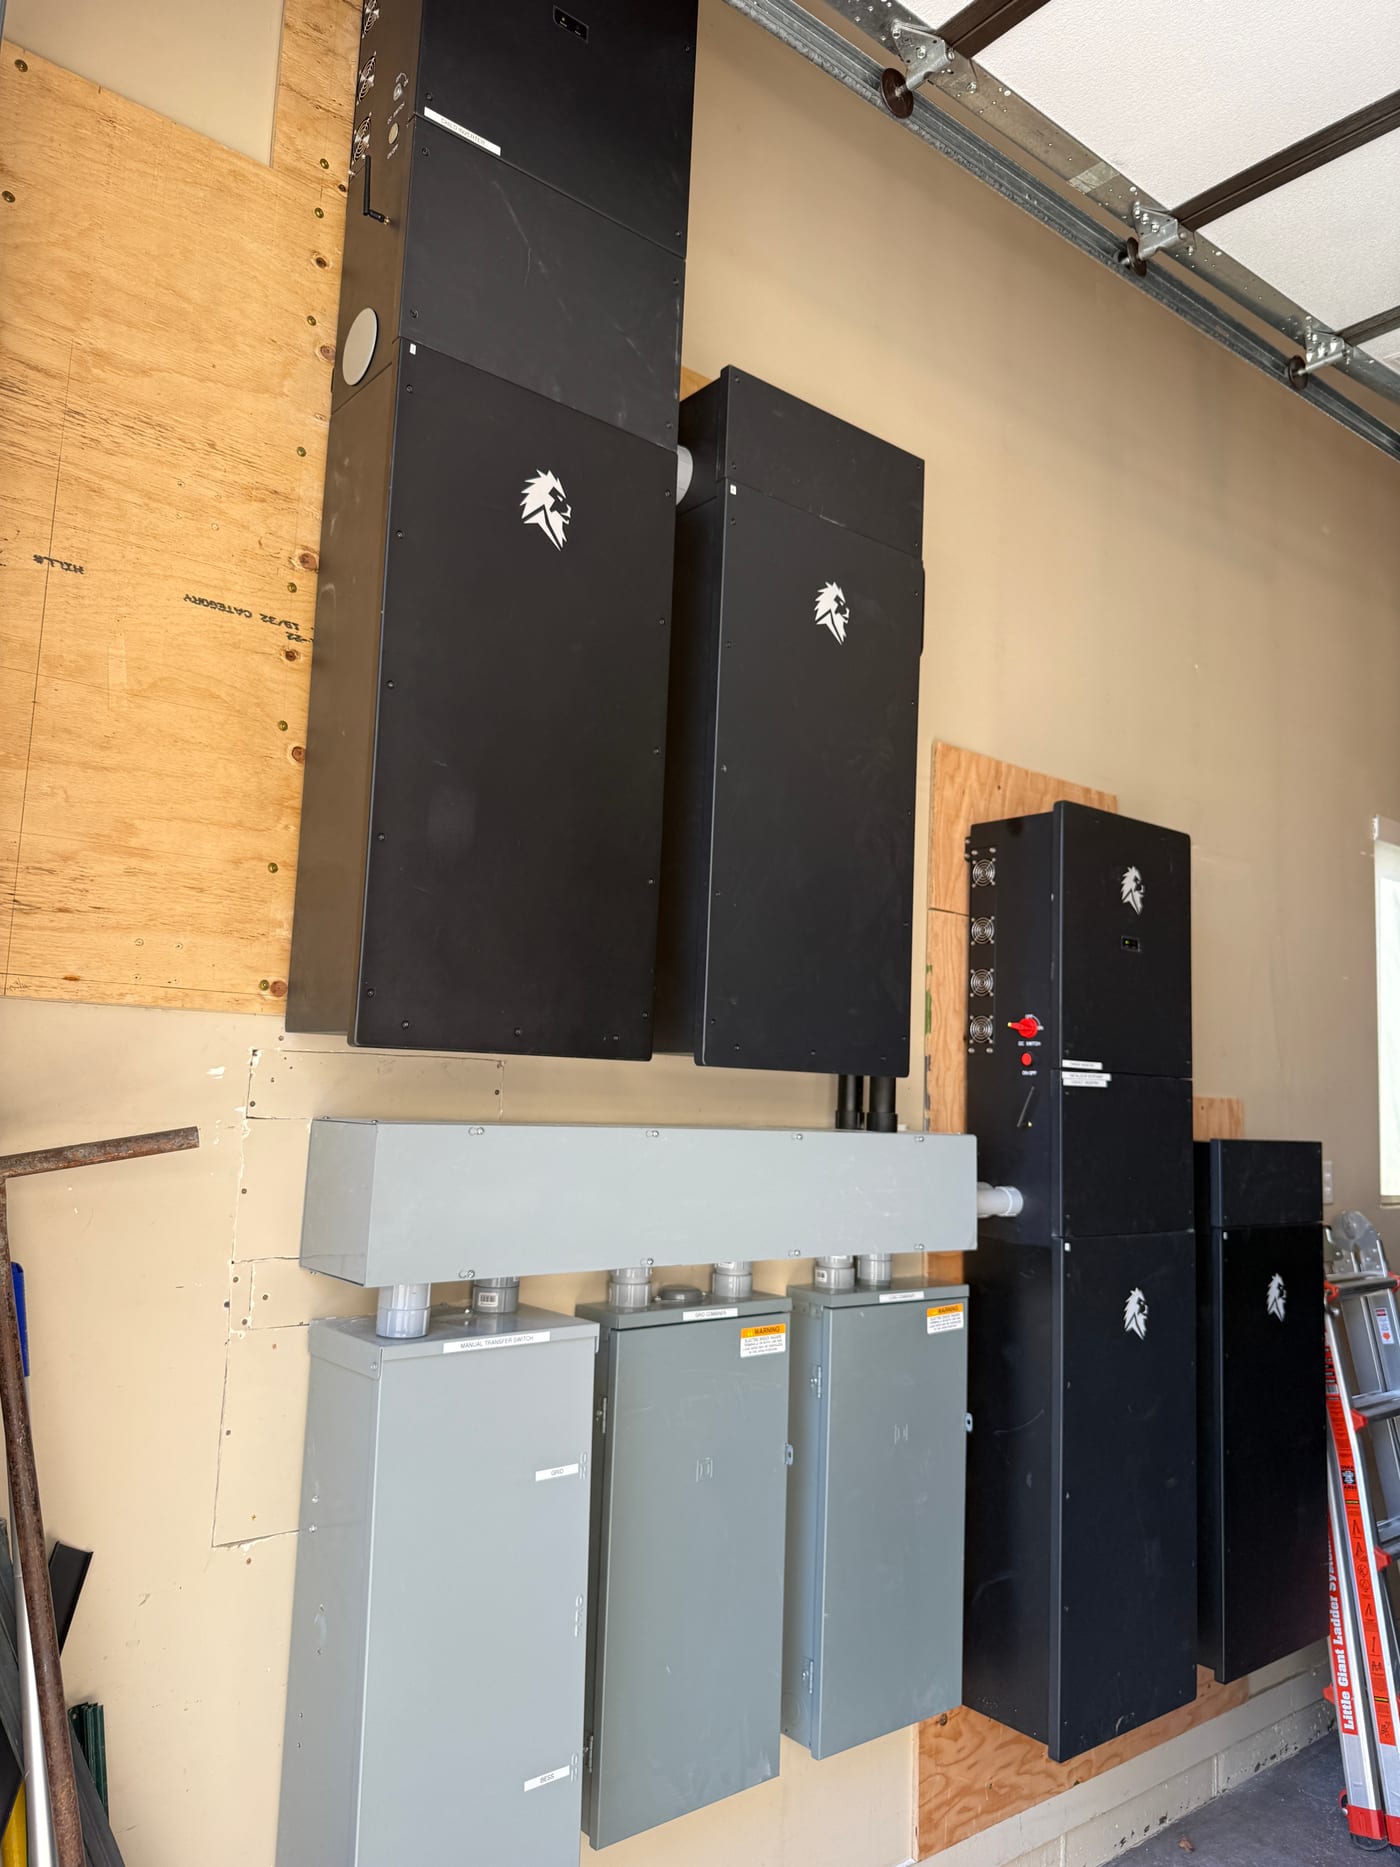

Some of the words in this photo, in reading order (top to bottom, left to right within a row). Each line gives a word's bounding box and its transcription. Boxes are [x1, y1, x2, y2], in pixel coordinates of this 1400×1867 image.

[183, 593, 252, 618] CATEGORY
[259, 613, 300, 631] 19/32
[285, 631, 314, 643] -22
[754, 1325, 780, 1336] WARNING
[460, 1341, 483, 1349] MANUAL
[484, 1337, 512, 1346] TRANSFER
[513, 1335, 534, 1343] SWITCH
[551, 1468, 564, 1476] GRID
[1330, 1595, 1343, 1645] Ladder
[1335, 1648, 1348, 1687] Giant
[1341, 1691, 1354, 1730] Little
[540, 1772, 555, 1783] BESS
